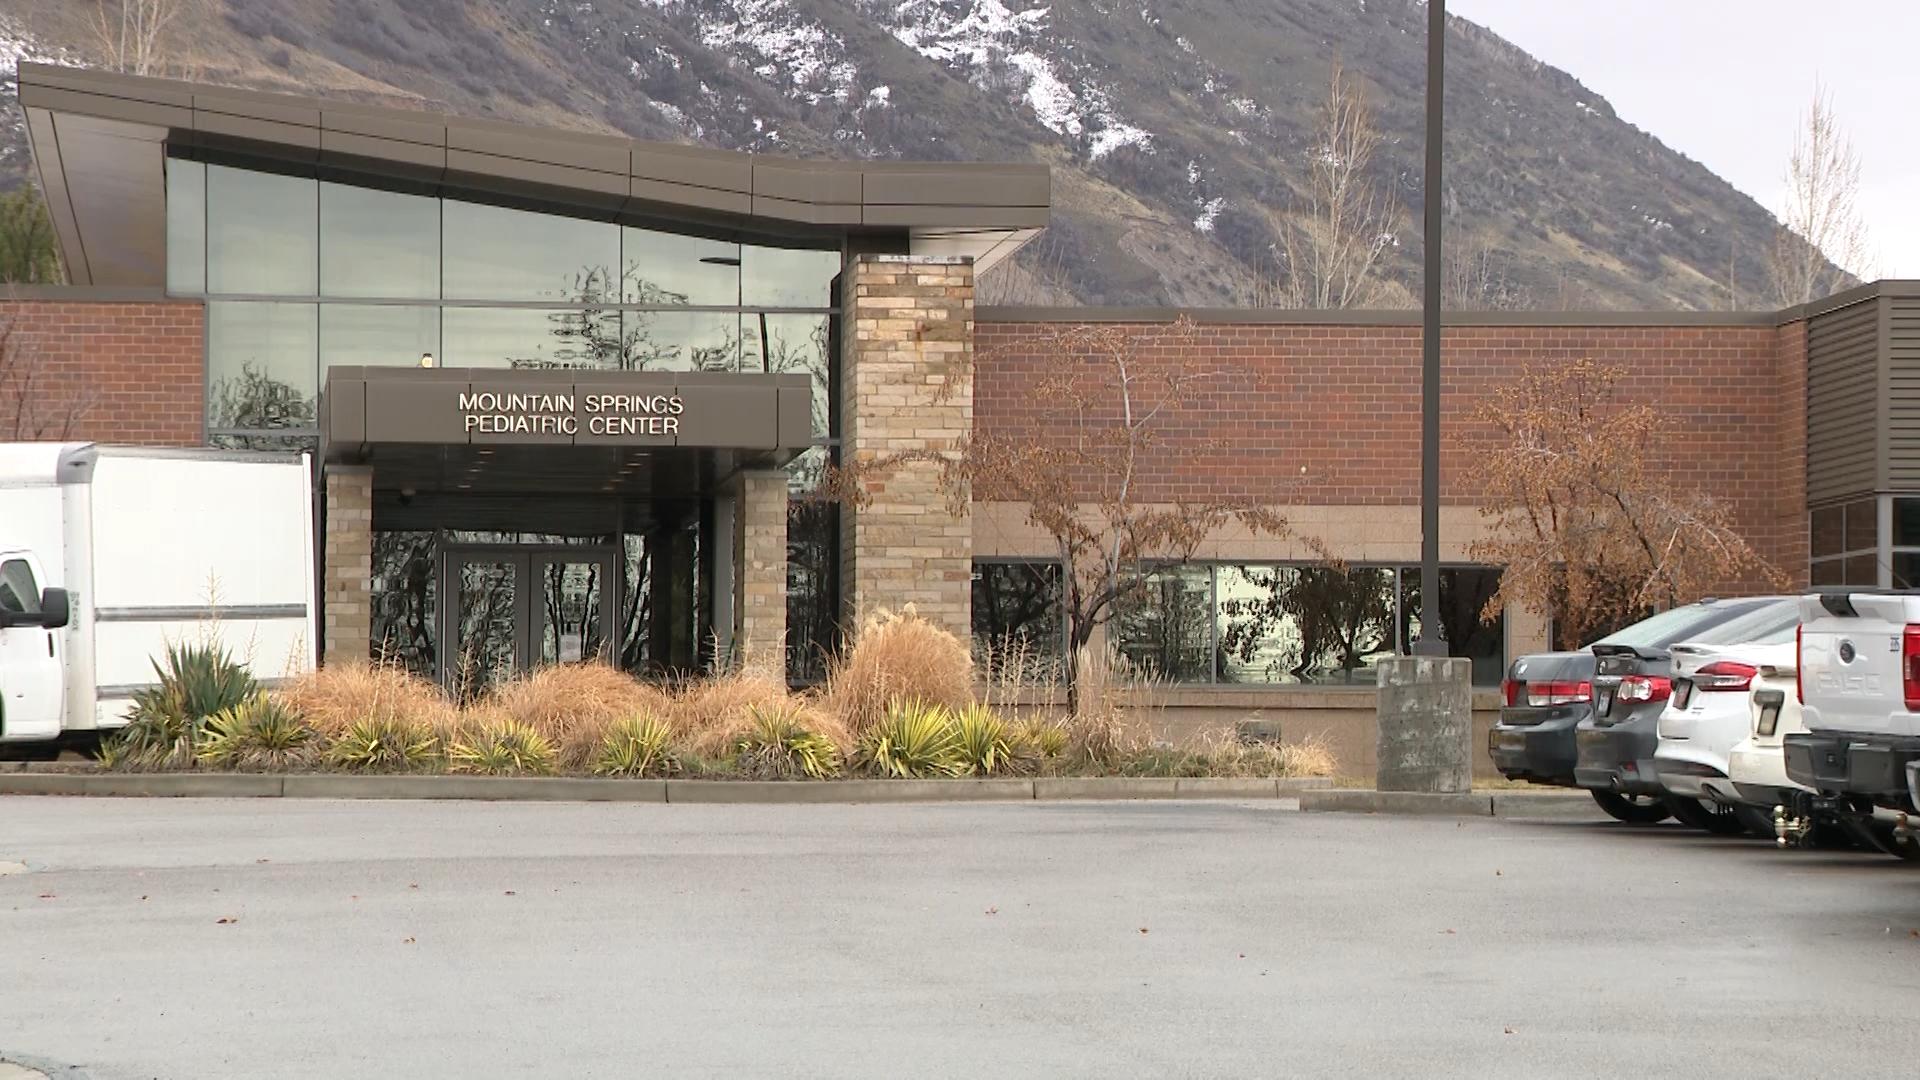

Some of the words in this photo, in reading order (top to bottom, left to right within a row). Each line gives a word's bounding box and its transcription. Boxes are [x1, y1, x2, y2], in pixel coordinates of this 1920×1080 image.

[459, 393, 575, 412] MOUNTAIN
[585, 395, 683, 414] SPRINGS
[465, 415, 578, 434] PEDIATRIC
[589, 416, 678, 435] CENTER
